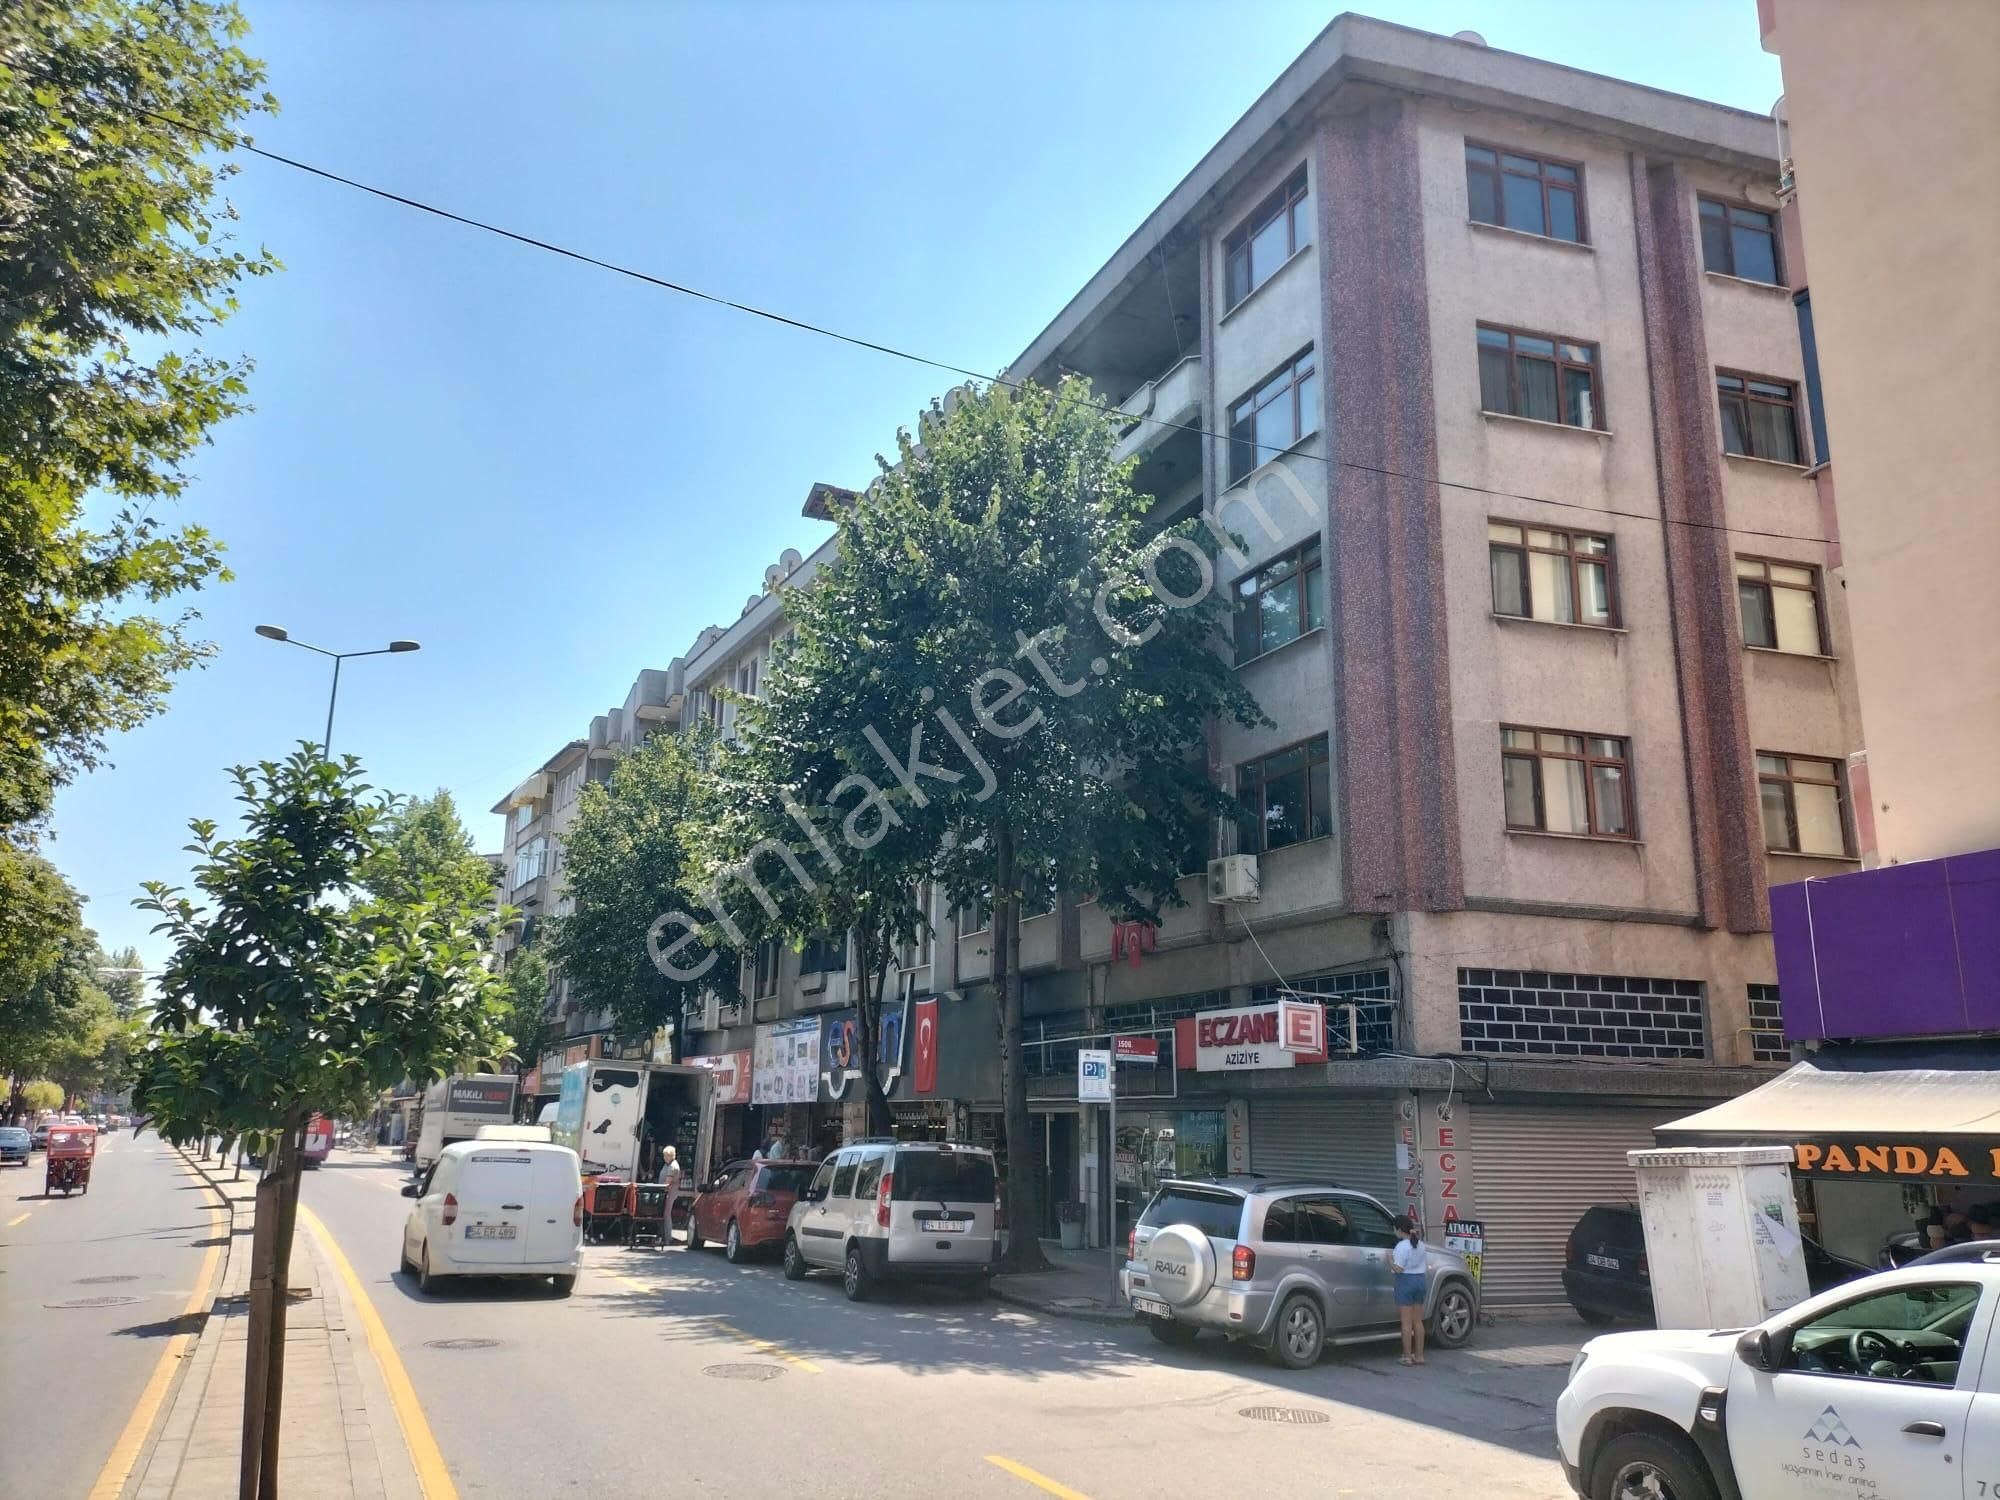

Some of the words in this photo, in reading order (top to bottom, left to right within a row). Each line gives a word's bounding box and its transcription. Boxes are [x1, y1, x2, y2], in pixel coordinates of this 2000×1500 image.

[1291, 1012, 1313, 1043] E
[1225, 1050, 1260, 1066] AZİZİYE
[1794, 1143, 1970, 1176] PANDA
[1447, 1222, 1481, 1235] ATMACA
[1154, 1260, 1187, 1276] RAV4
[1802, 1447, 1866, 1472] sedaş
